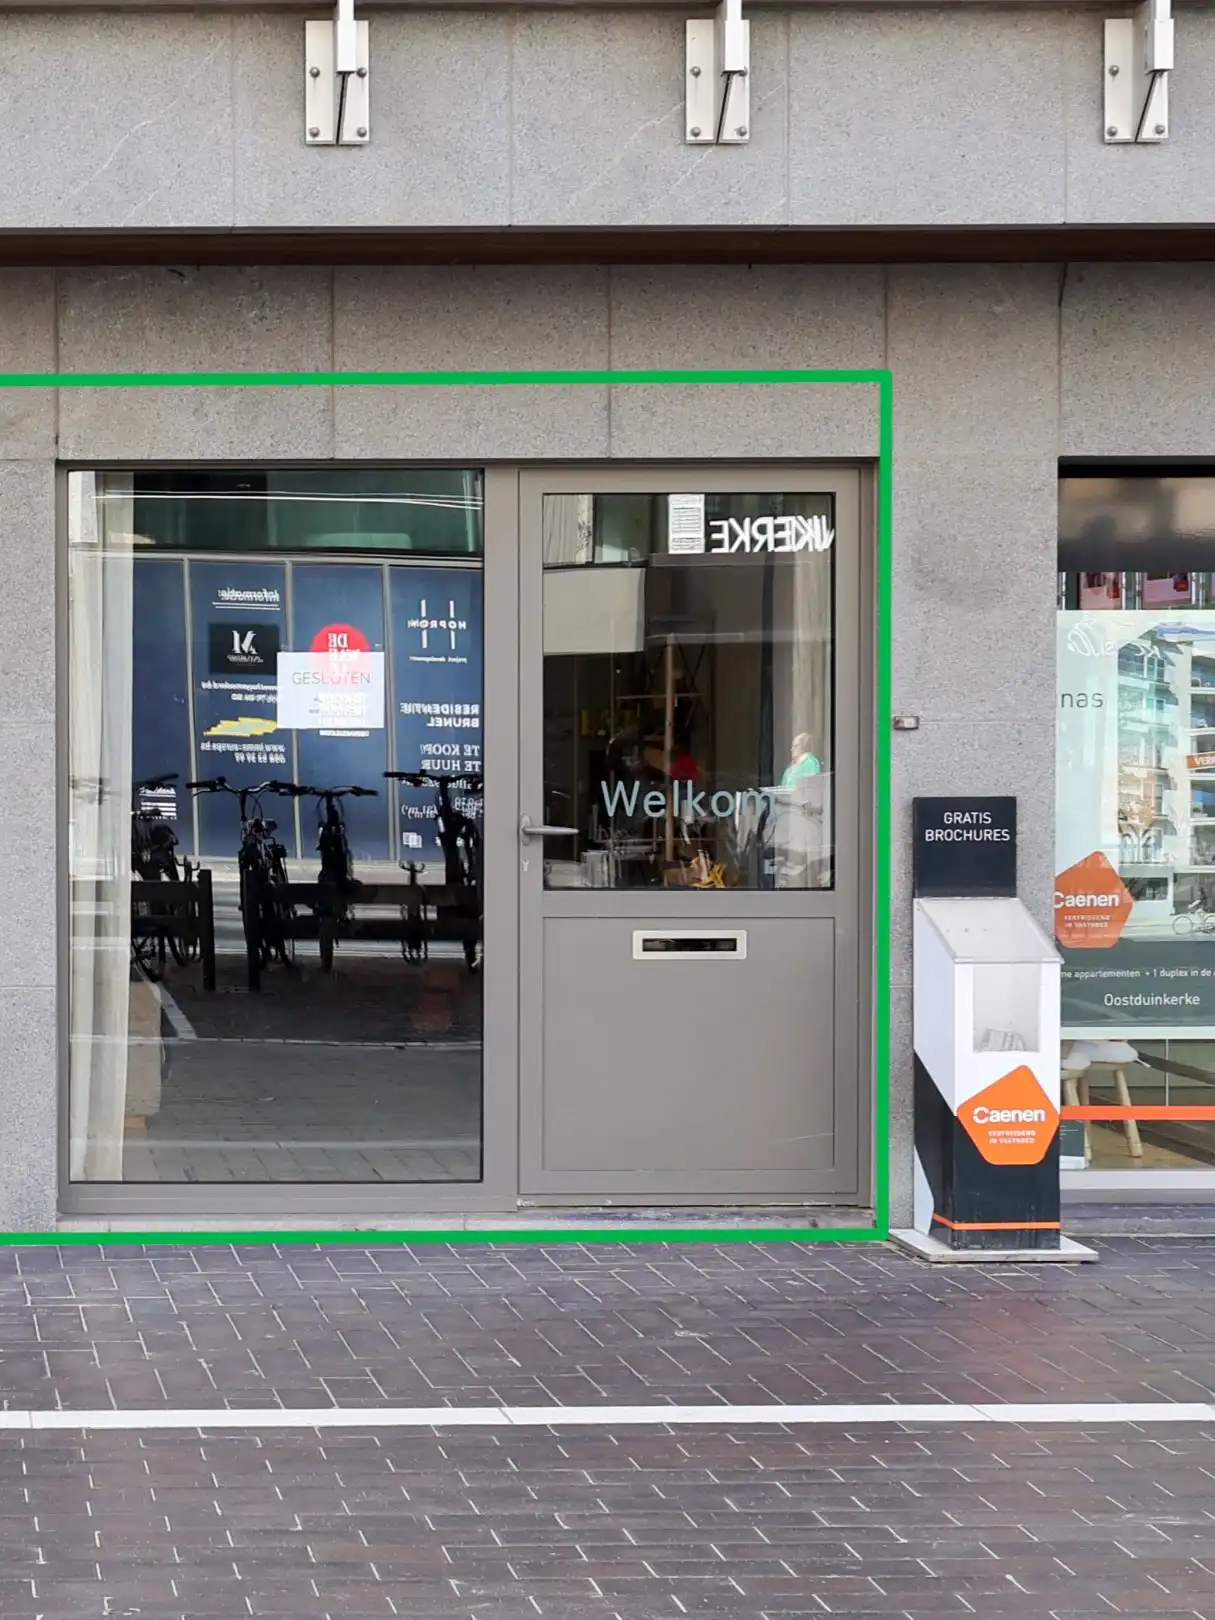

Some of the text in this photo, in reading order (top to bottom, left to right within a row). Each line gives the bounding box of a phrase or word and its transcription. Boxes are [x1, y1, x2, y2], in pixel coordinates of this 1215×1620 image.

[292, 671, 371, 686] GESLOTEN
[600, 780, 776, 819] Welkom
[943, 811, 992, 825] GRATIS
[925, 828, 1011, 842] BROCHURES
[1053, 891, 1120, 909] Caenen
[1074, 969, 1141, 979] appartementen
[1159, 967, 1189, 979] duplex
[1190, 967, 1199, 977] in
[1200, 967, 1212, 977] de
[1103, 992, 1201, 1006] Oostduinkerke
[972, 1106, 1046, 1124] Caenen
